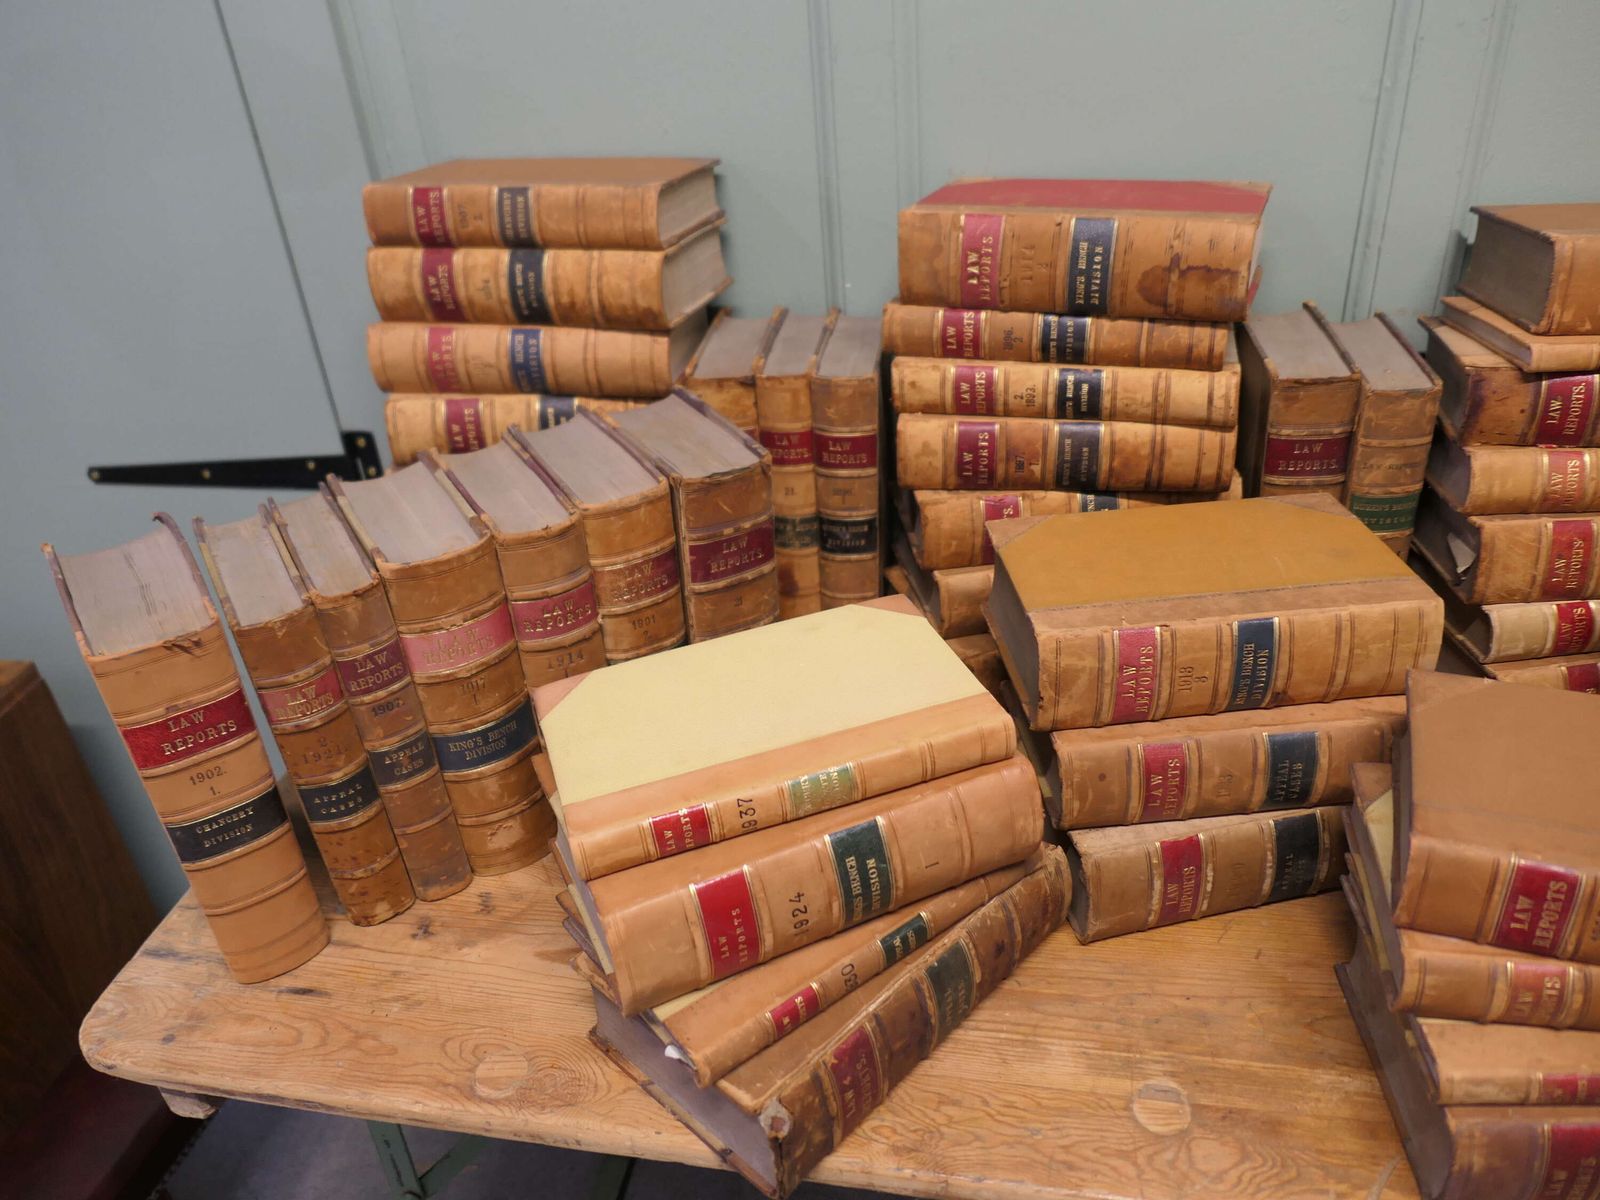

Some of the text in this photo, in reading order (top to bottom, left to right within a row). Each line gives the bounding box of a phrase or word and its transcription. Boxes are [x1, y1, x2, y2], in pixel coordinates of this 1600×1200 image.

[417, 205, 430, 232] LAW
[966, 248, 979, 285] LAW
[980, 235, 994, 301] REPORTS
[1077, 240, 1088, 270] BENCH
[428, 275, 441, 302] LAW
[946, 325, 957, 350] LAW
[964, 311, 975, 358] REPORTS
[960, 382, 970, 404] LAW
[975, 370, 986, 415] REPORTS
[452, 423, 464, 448] LAW
[465, 407, 479, 450] EPORTS
[774, 434, 800, 445] LAW
[822, 452, 868, 464] REPORTS
[828, 440, 852, 450] LAW
[977, 431, 989, 485] REPORTS
[1293, 442, 1324, 454] LAW
[960, 451, 973, 478] LAW
[1551, 471, 1563, 498] LAW
[1563, 458, 1580, 507] REPORTS
[722, 536, 748, 554] LAW
[622, 561, 655, 580] LAW
[1552, 556, 1567, 583] LAW
[523, 604, 593, 633] REPORTS
[541, 599, 575, 618] LAW
[437, 627, 481, 650] LAW
[1559, 622, 1571, 648] LAW
[356, 650, 388, 673] LAW
[1243, 642, 1255, 675] BENCH
[349, 660, 406, 693] REPORTS
[1123, 664, 1138, 698] LAW
[1135, 645, 1154, 713] REPORTS
[1253, 648, 1270, 702] DIVISION
[276, 693, 335, 720] REPORTS
[287, 684, 318, 706] LAW
[168, 709, 205, 732] LAW
[160, 719, 238, 756] REPORTS
[447, 719, 519, 753] KING'S BENCH
[463, 736, 508, 762] DIVISION
[383, 739, 426, 765] APPEAL
[189, 765, 227, 786] 1902.
[394, 757, 426, 777] CASES
[1149, 773, 1163, 807] LAW
[1162, 757, 1181, 816] REPORTS
[195, 805, 255, 835] CHANCERY
[203, 824, 254, 849] DIVISION
[663, 828, 675, 850] LAW
[844, 855, 863, 895] BENCH
[1165, 881, 1178, 910] LAW
[1177, 865, 1196, 914] REPORTS
[1510, 894, 1535, 931] LAW
[1532, 879, 1568, 950] REPORTS
[721, 934, 731, 959] LAW
